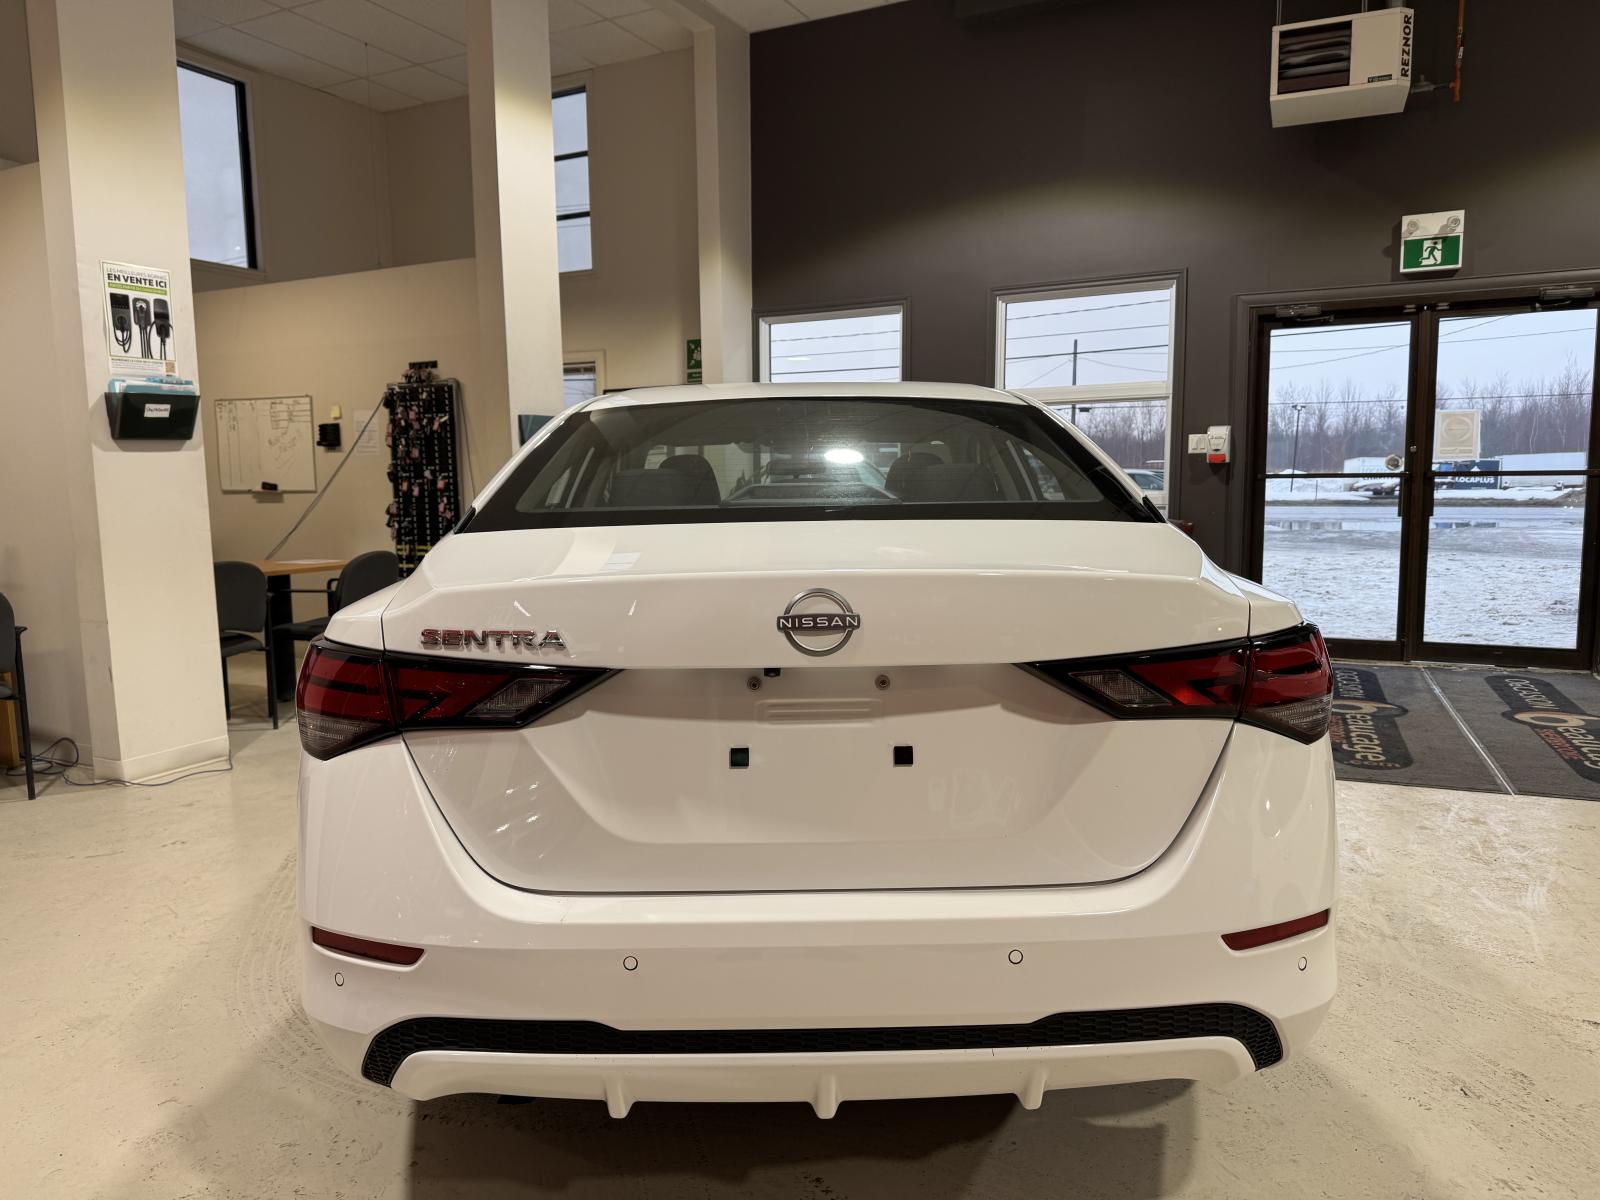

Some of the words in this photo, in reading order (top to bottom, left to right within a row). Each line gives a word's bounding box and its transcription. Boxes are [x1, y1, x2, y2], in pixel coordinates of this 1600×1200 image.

[1400, 14, 1413, 78] REZNOR
[107, 273, 121, 282] EN
[122, 275, 155, 287] VENTE
[155, 280, 168, 289] ICI
[1455, 475, 1495, 484] LOCAPLUS
[779, 616, 859, 628] NISSAN
[420, 628, 566, 650] SENTRA
